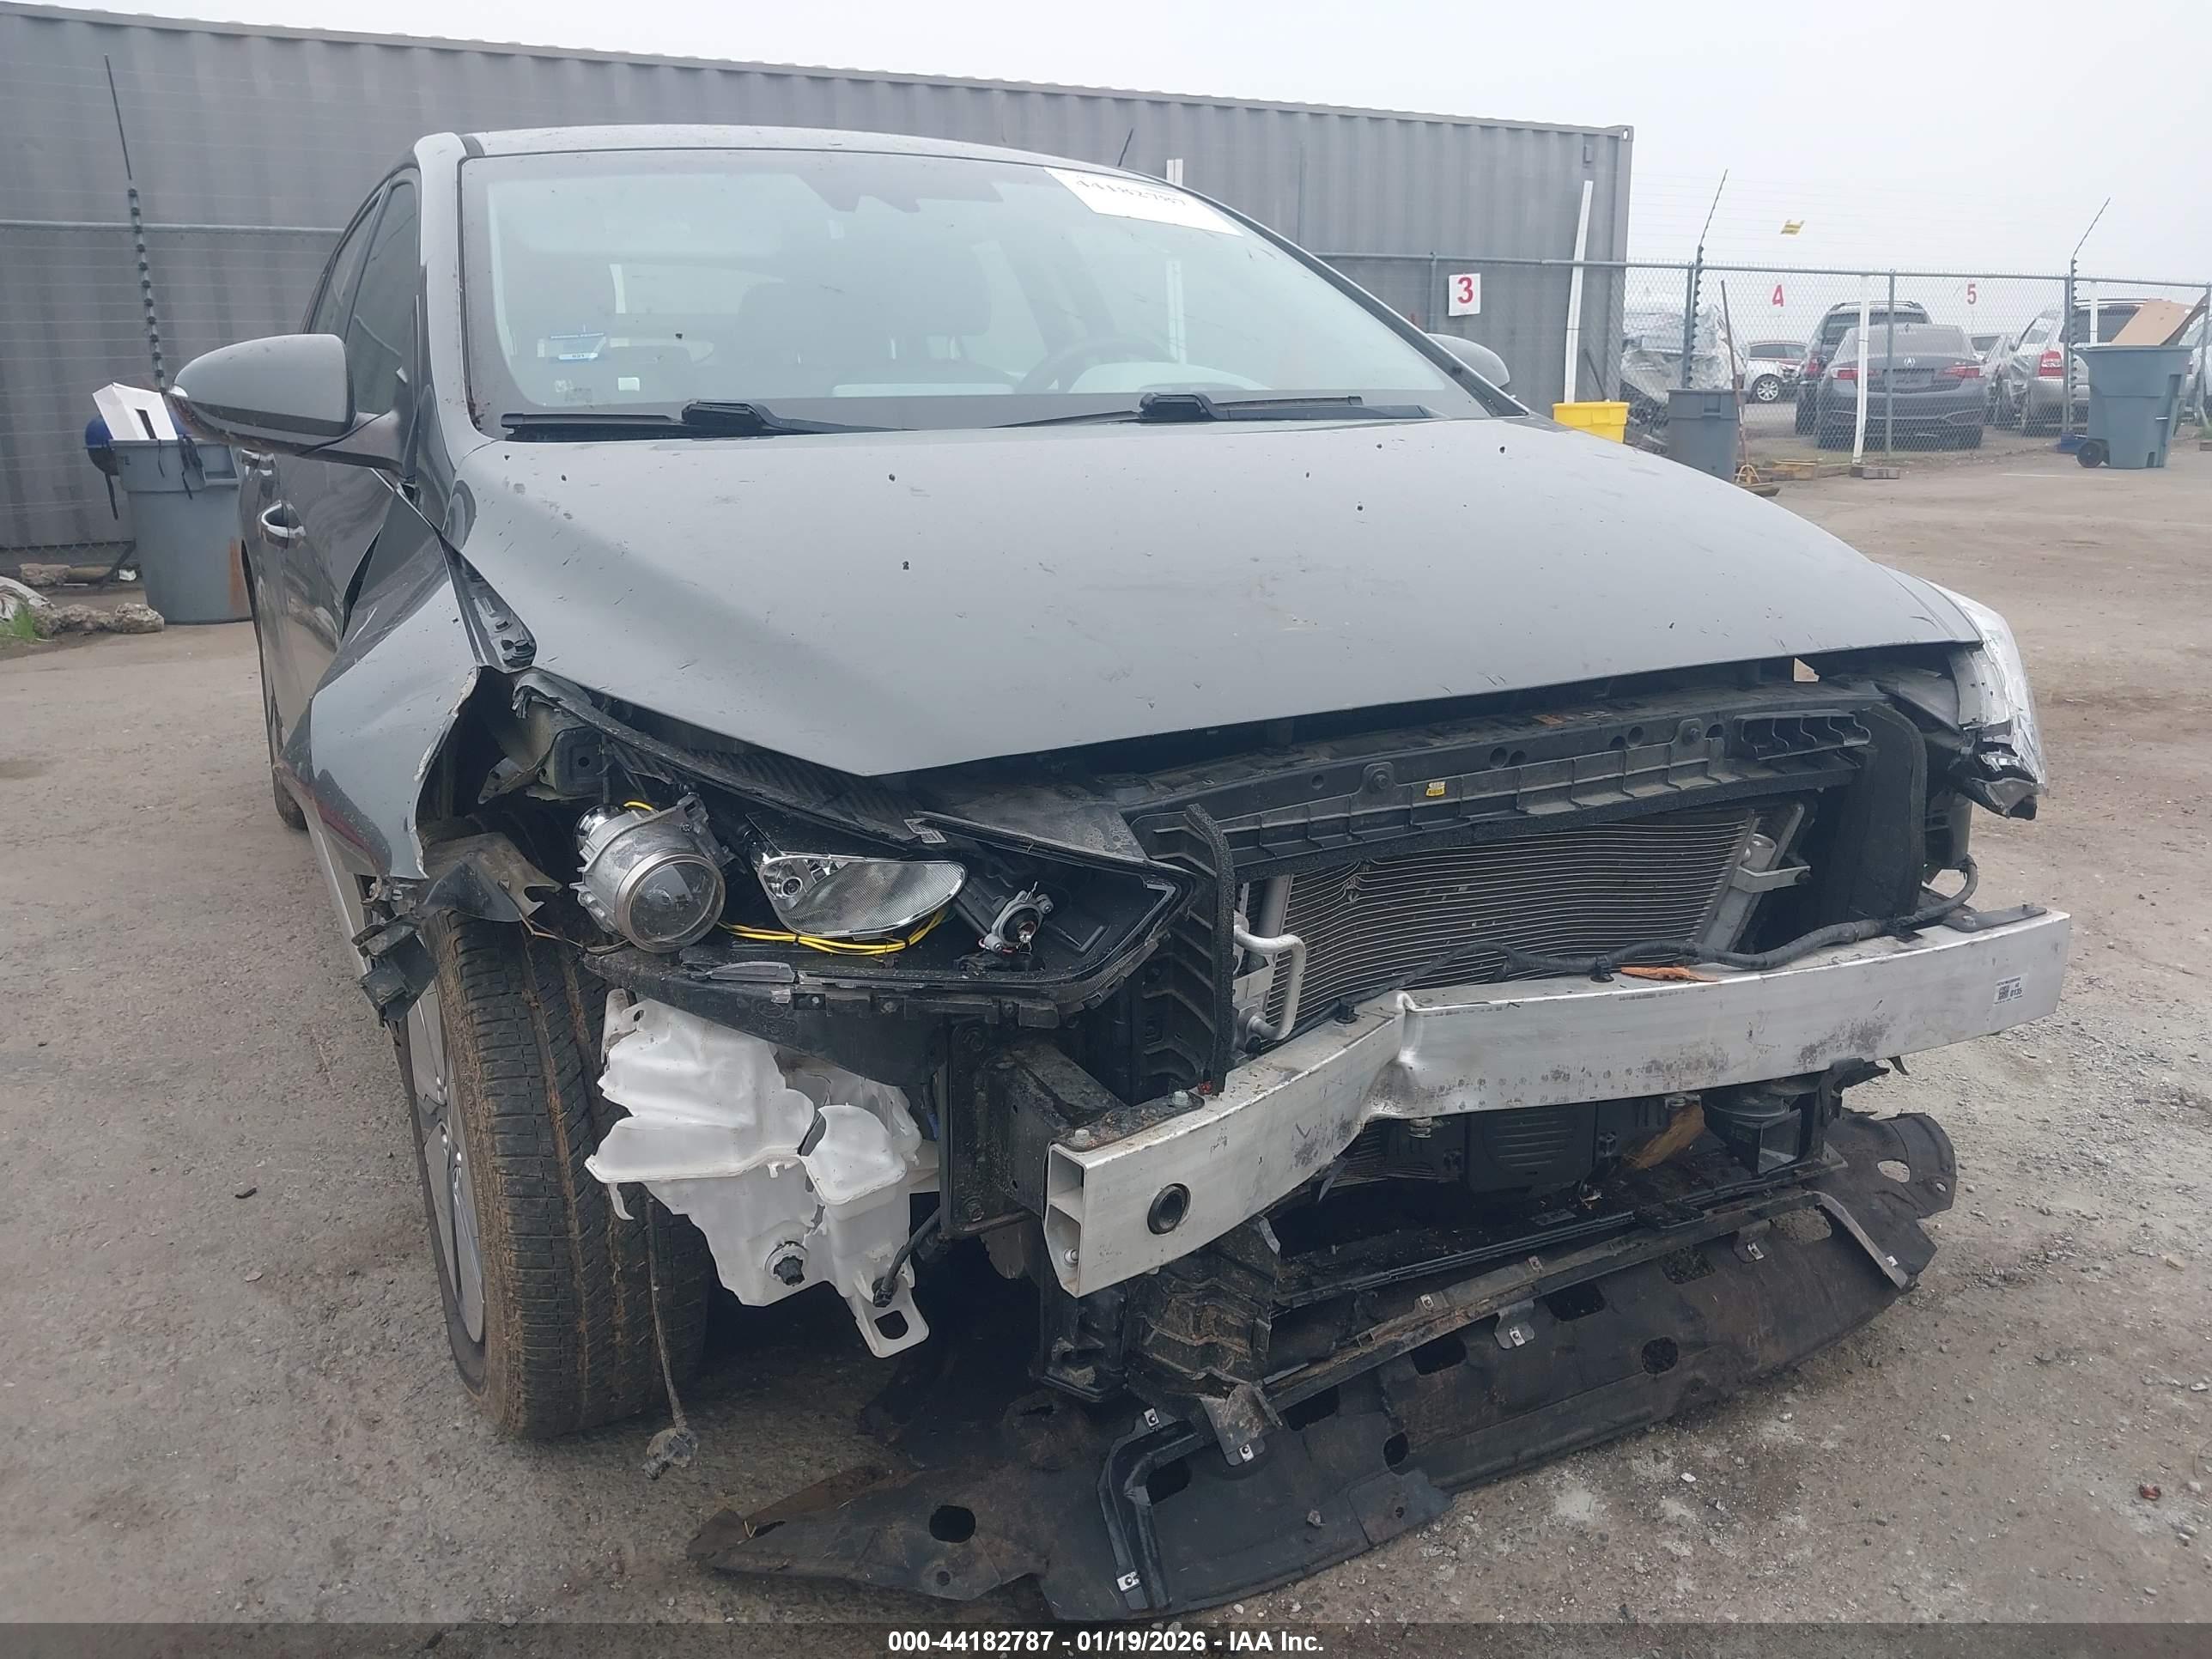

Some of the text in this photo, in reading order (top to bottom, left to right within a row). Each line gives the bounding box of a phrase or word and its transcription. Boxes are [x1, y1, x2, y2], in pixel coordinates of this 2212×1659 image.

[1456, 276, 1474, 305] 3
[1771, 284, 1785, 307] 4
[1966, 283, 1978, 305] 5
